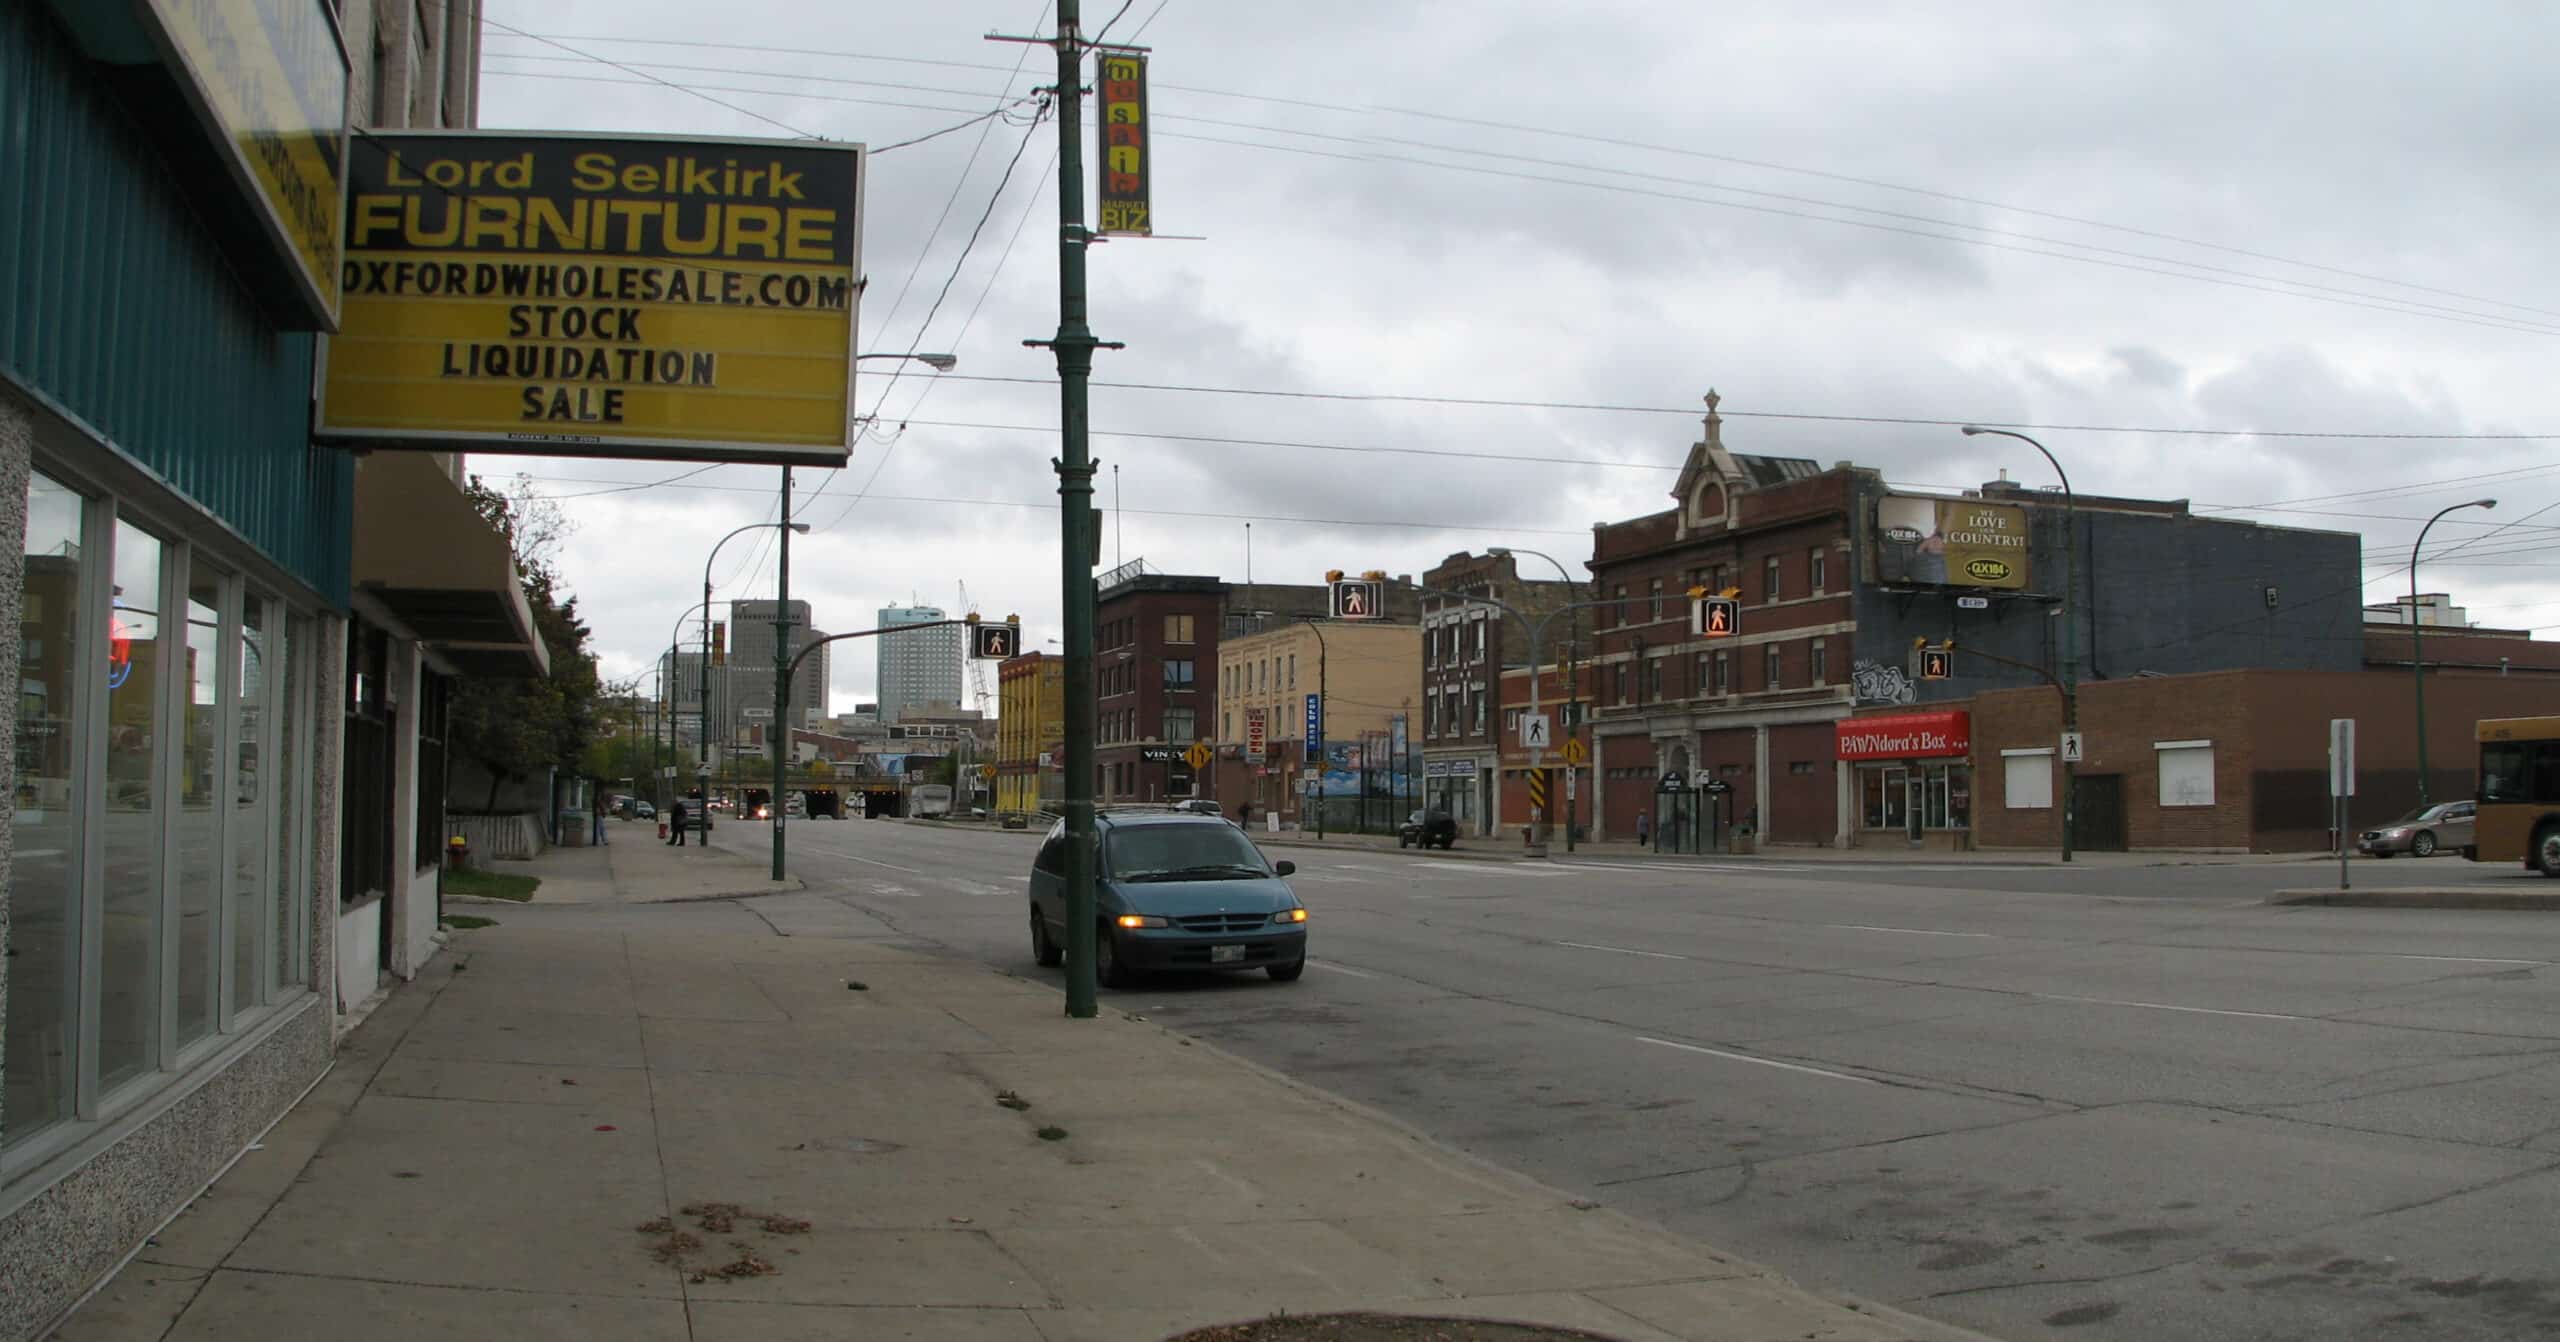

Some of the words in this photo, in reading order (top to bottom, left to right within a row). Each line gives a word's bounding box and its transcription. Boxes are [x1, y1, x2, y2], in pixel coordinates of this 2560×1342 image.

[386, 152, 534, 189] Lord
[572, 153, 805, 199] Selkirk
[354, 195, 836, 261] FURNITURE
[1102, 208, 1148, 230] BIZ
[342, 261, 846, 308] OXFORDWHOLESALE.COM
[510, 304, 641, 341] STOCK
[442, 343, 714, 385] LIQUIDATION
[523, 386, 624, 421] SALE
[1950, 531, 2025, 547] COUNTRY!
[1969, 515, 2007, 529] LOVE
[1248, 721, 1265, 753] HOTEL
[1840, 732, 1919, 754] PAWNdora's
[1921, 731, 1946, 750] Box
